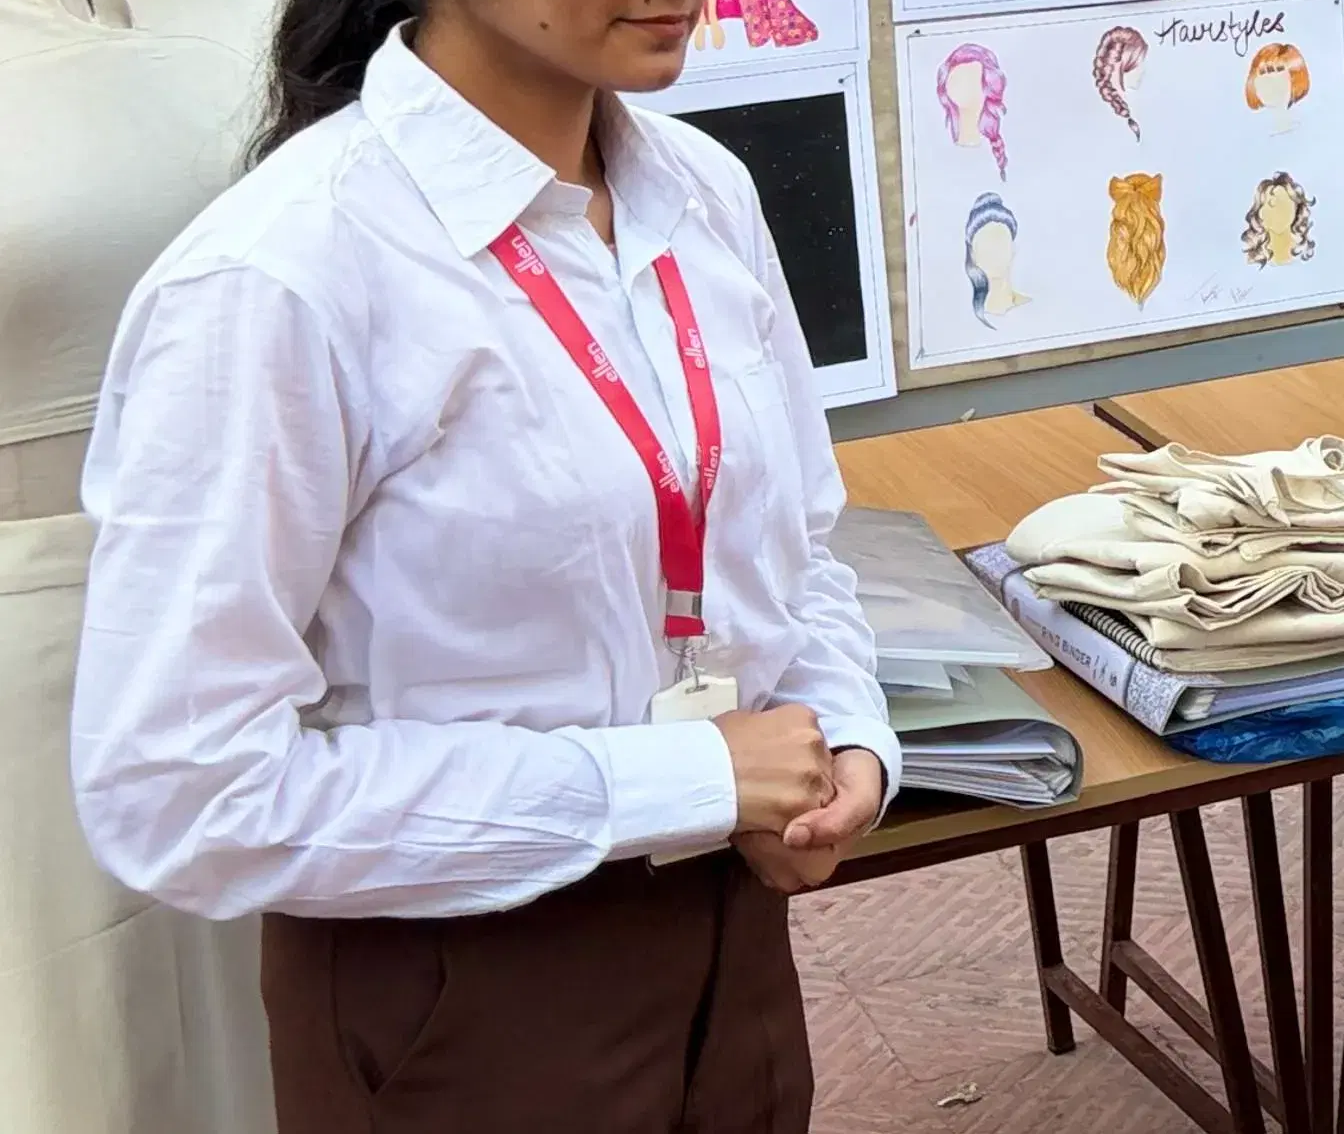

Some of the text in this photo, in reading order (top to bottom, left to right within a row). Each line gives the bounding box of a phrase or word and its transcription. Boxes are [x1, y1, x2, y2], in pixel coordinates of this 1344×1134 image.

[1153, 9, 1285, 57] Hairstyles
[512, 236, 544, 276] ellen
[587, 341, 618, 383] ellen
[686, 329, 705, 368] ellen
[656, 450, 680, 493] ellen
[706, 446, 719, 490] ellen
